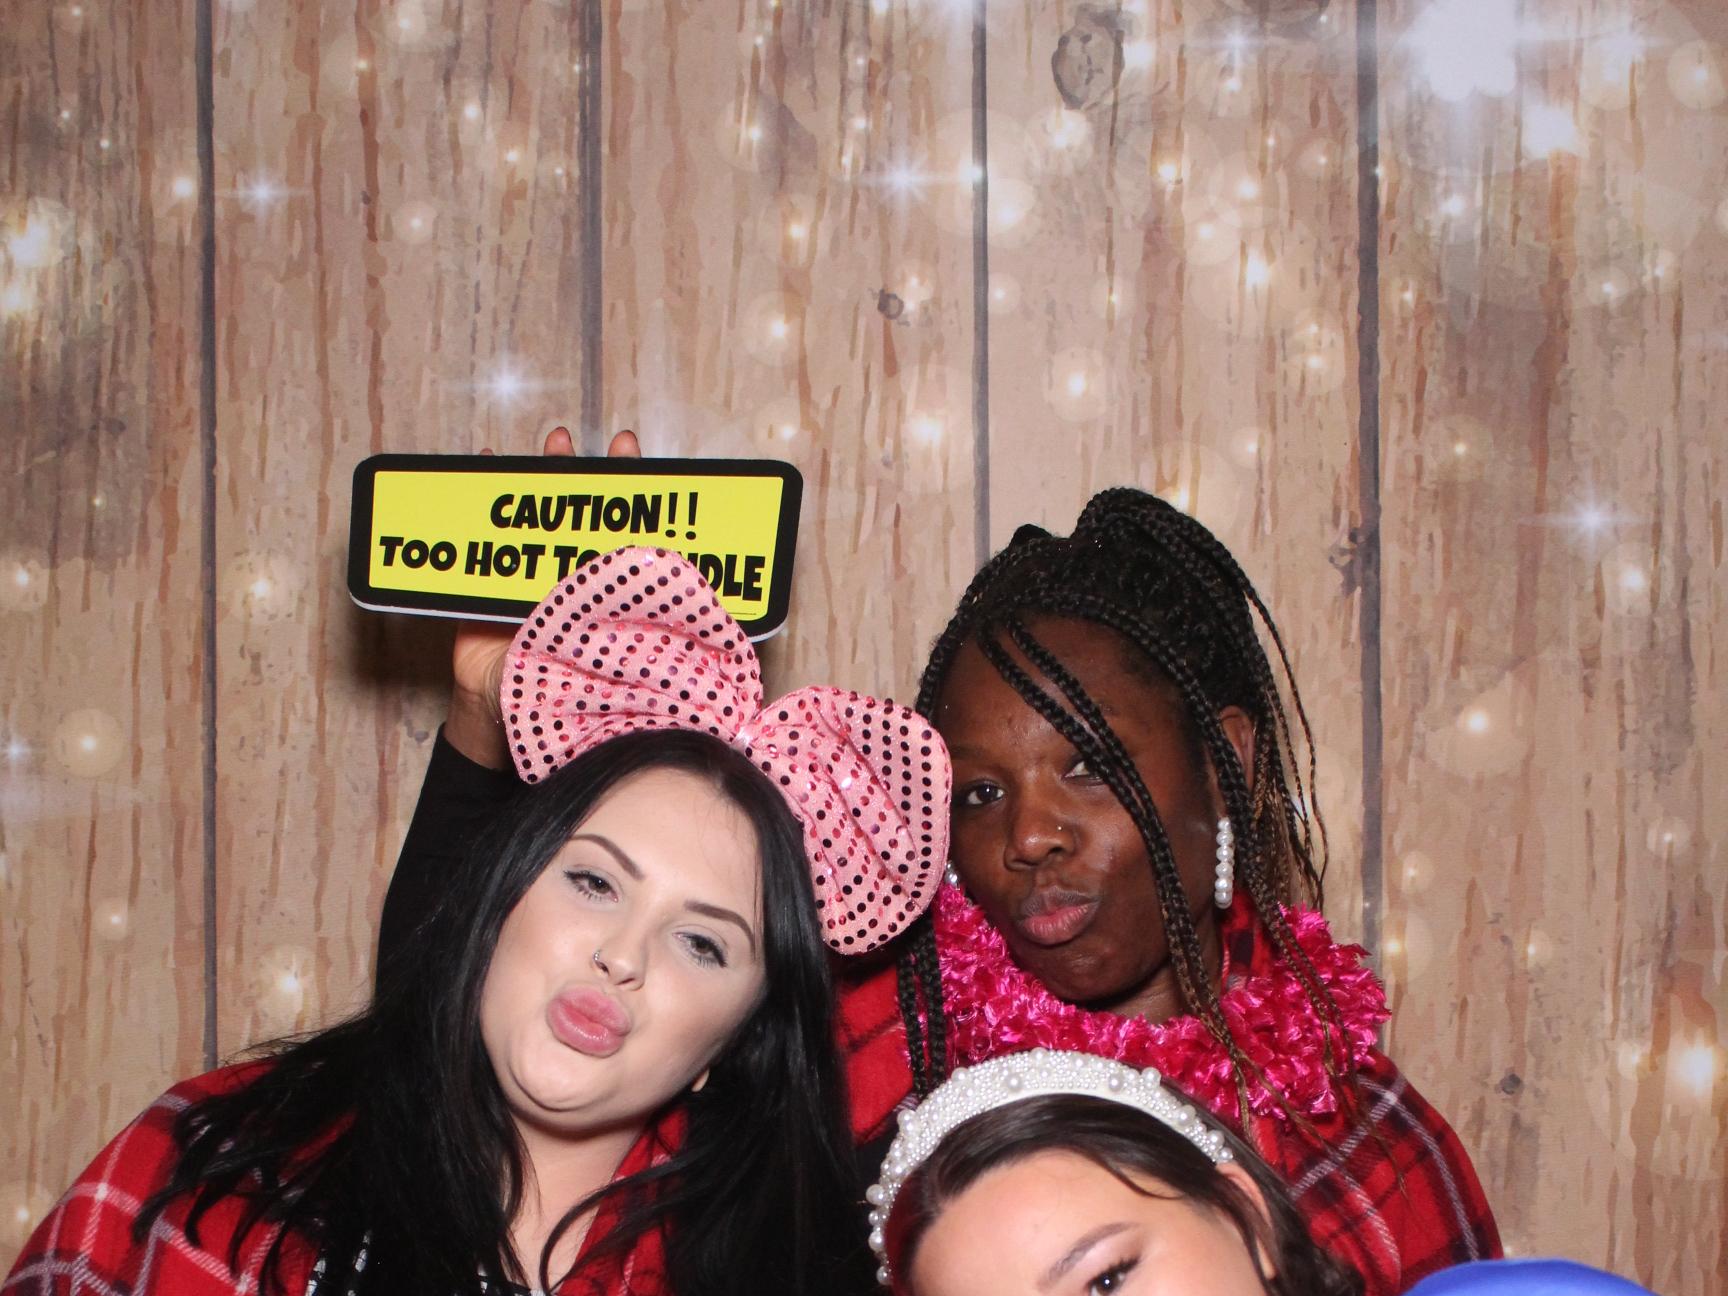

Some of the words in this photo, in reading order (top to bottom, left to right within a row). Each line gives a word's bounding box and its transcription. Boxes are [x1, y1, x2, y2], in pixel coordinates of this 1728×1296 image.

[489, 491, 699, 541] CAUTION!!
[379, 535, 457, 572] TOO
[465, 541, 546, 580] HOT
